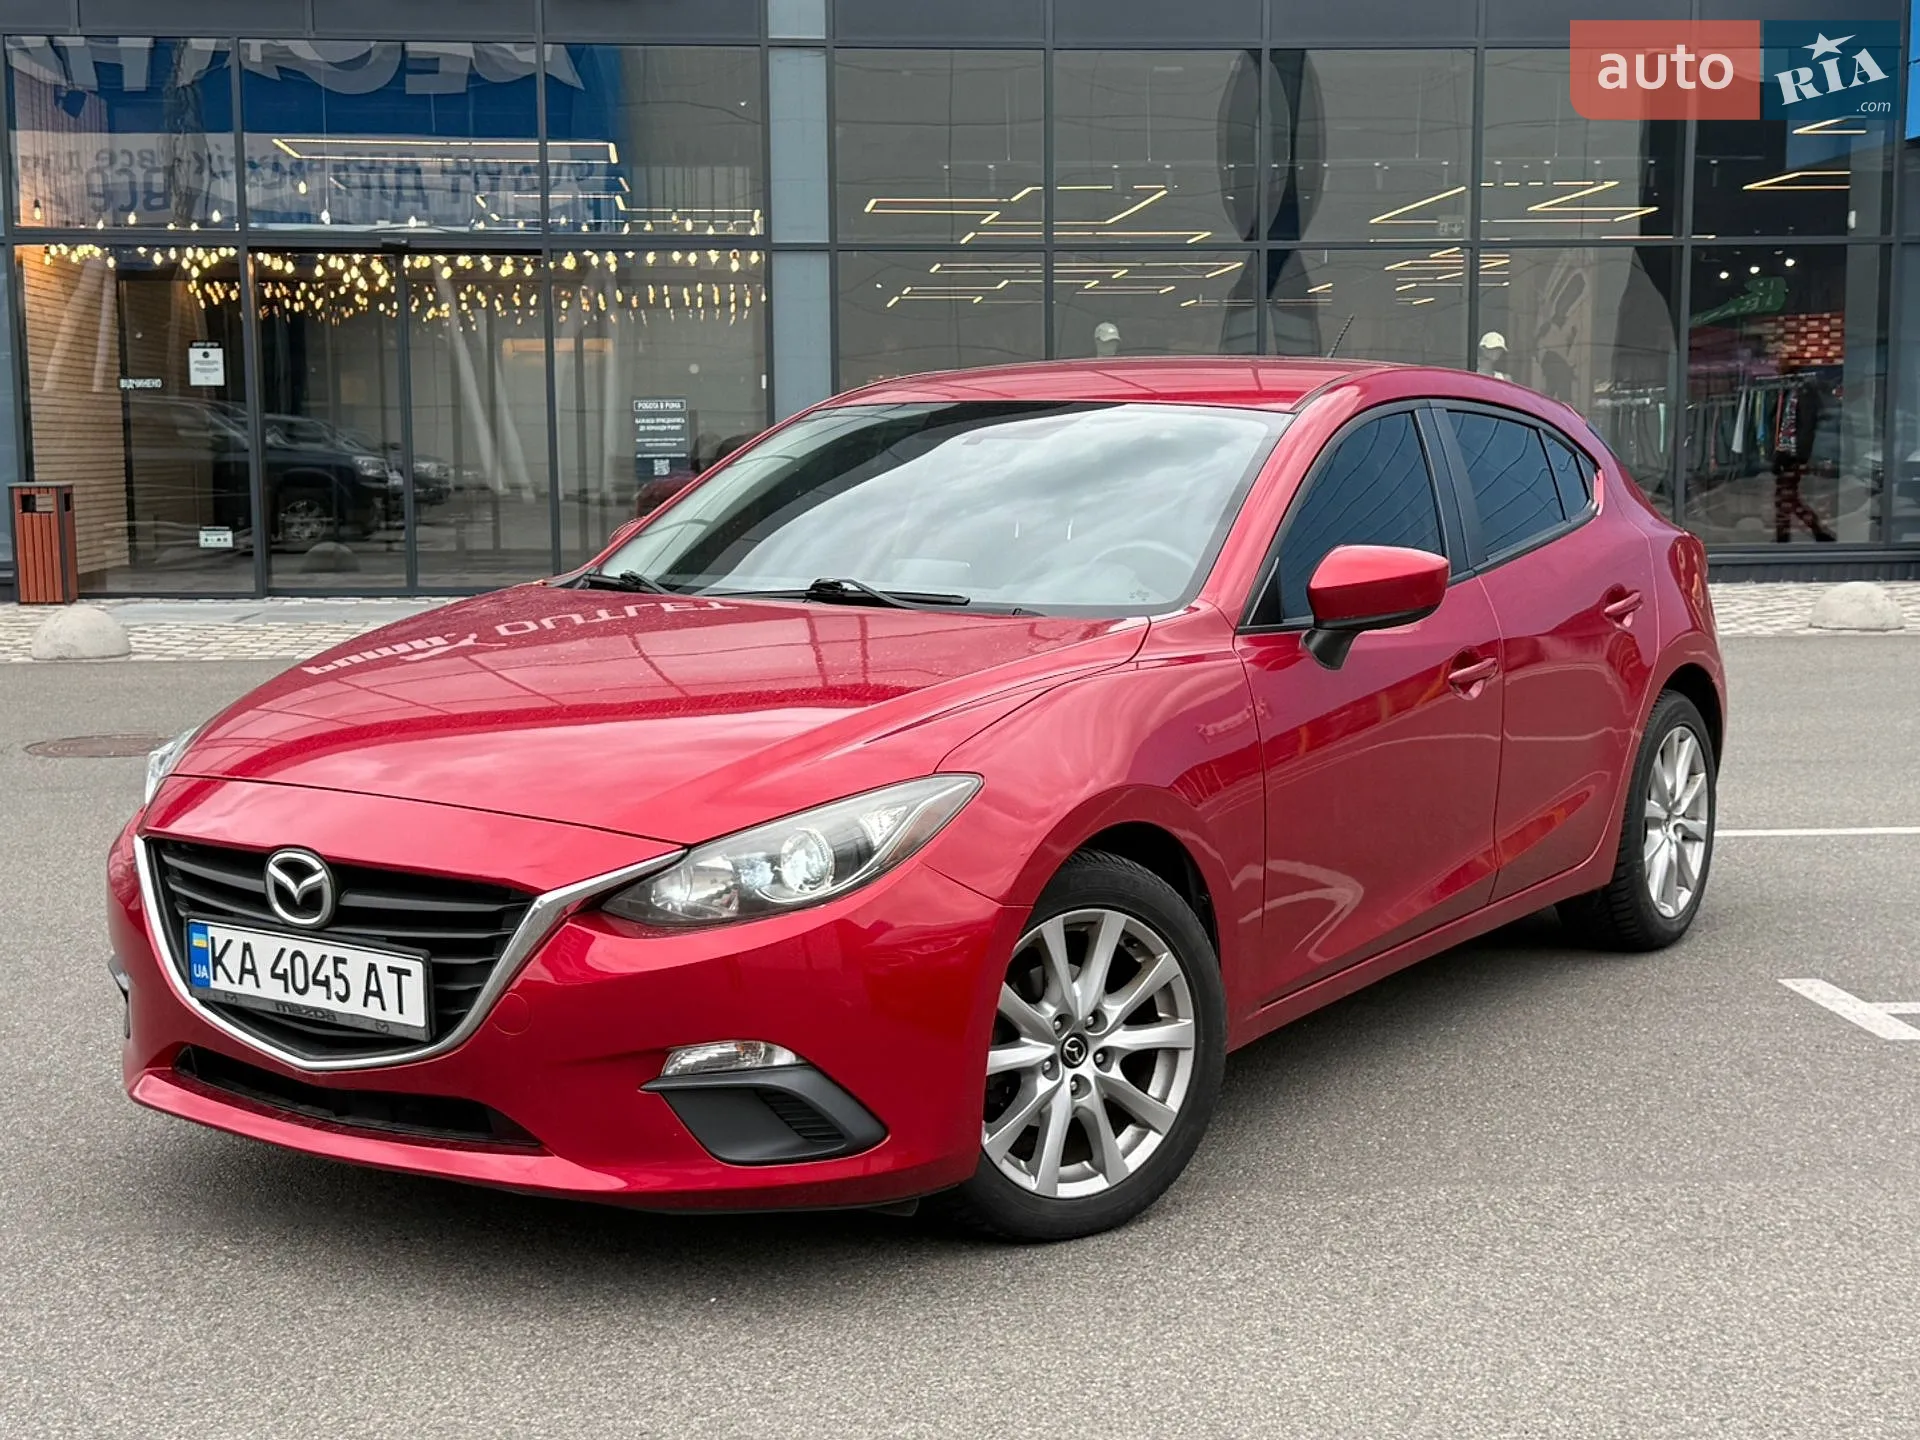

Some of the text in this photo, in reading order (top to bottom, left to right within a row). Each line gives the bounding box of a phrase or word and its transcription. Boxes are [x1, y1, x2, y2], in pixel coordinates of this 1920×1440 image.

[193, 963, 209, 979] UA
[210, 935, 413, 1014] KA 4045 AT
